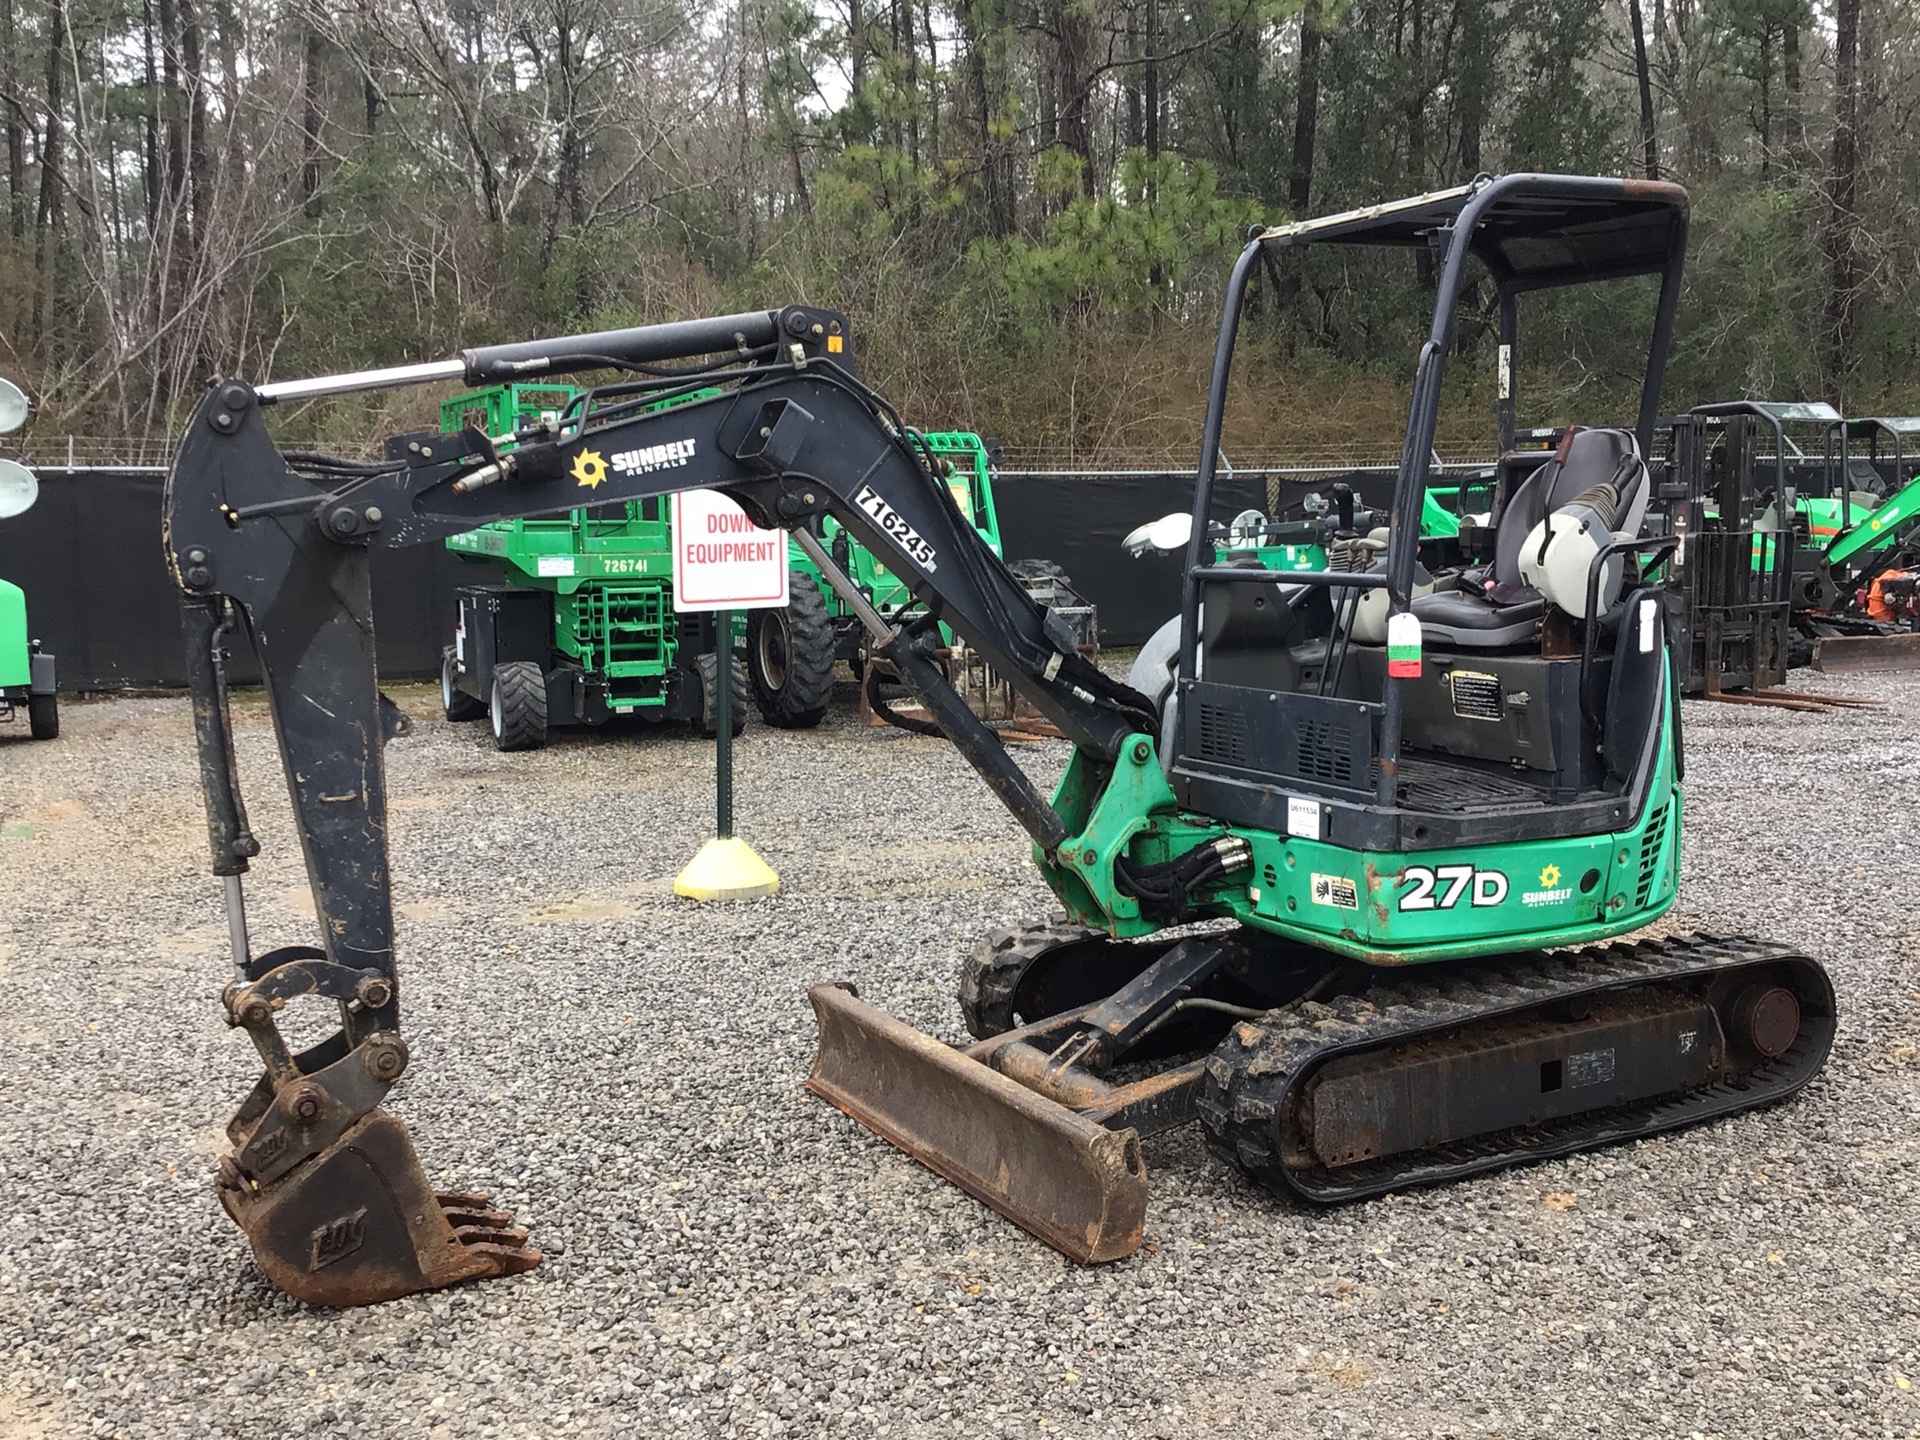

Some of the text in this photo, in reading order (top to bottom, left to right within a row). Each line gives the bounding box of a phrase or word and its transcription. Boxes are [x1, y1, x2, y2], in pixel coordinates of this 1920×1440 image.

[611, 438, 696, 472] SUNBELT
[626, 458, 688, 477] RENTALS
[707, 513, 755, 534] DOWN
[859, 487, 934, 564] 716245
[687, 542, 775, 564] EQUIPMENT
[1399, 864, 1509, 911] 27D
[1521, 888, 1573, 904] SUNBELT
